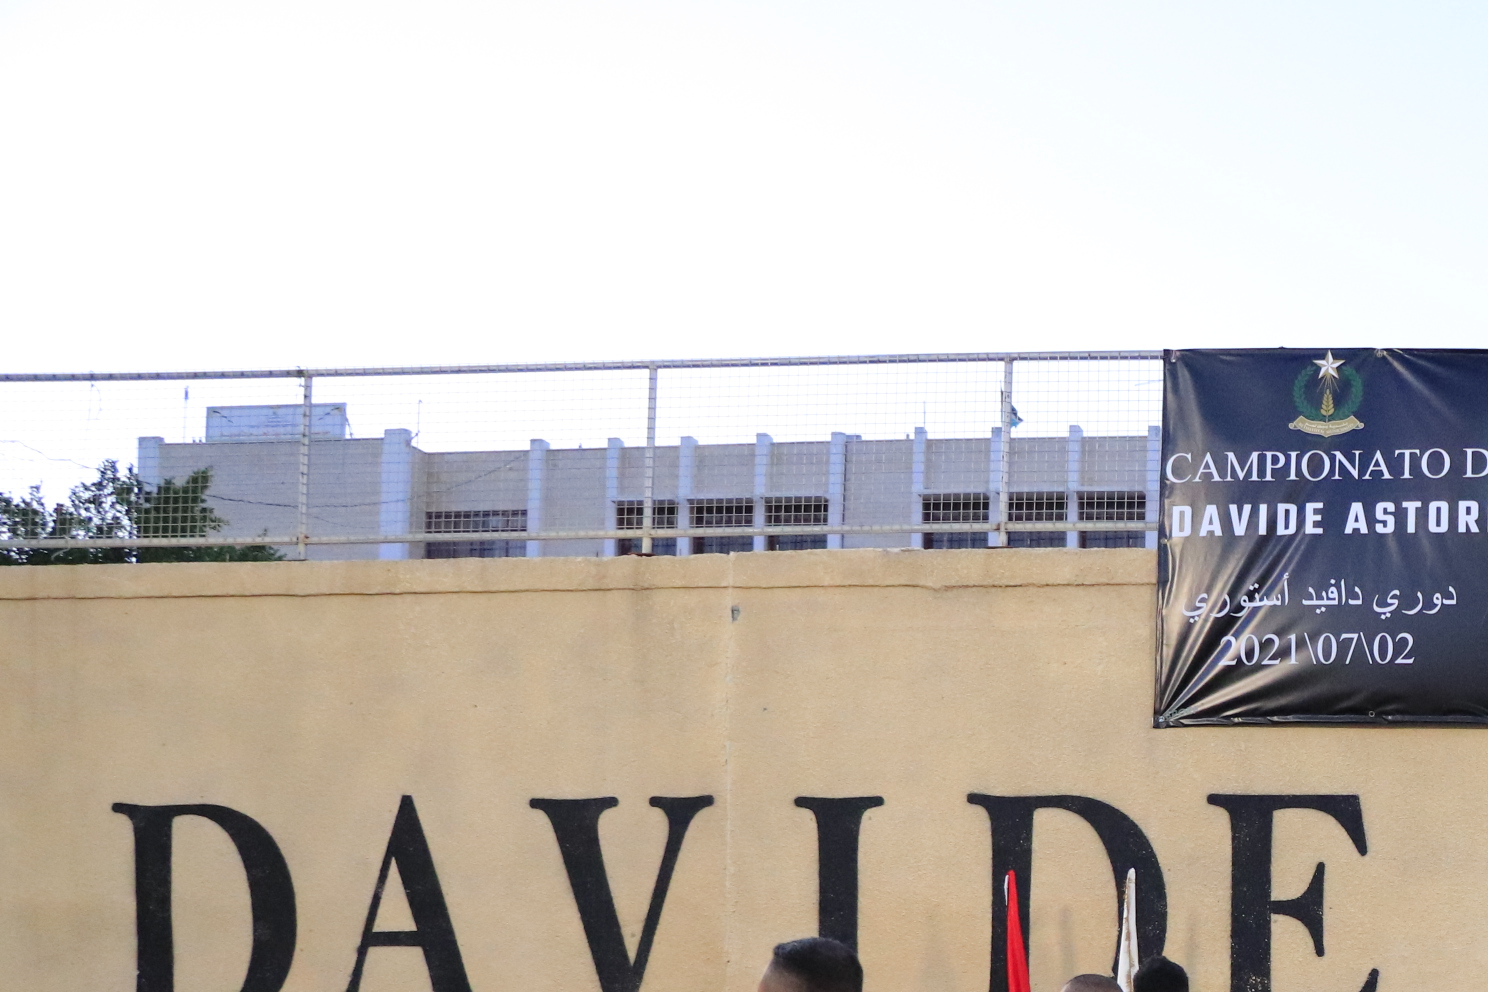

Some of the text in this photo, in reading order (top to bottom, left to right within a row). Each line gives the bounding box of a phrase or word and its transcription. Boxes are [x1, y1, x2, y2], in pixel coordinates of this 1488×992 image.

[1166, 448, 1450, 484] CAMPIONATO
[1172, 502, 1324, 538] DAVIDE
[1183, 573, 1457, 623] دوري دافيد أستوري
[1220, 631, 1416, 666] 2021\07\02
